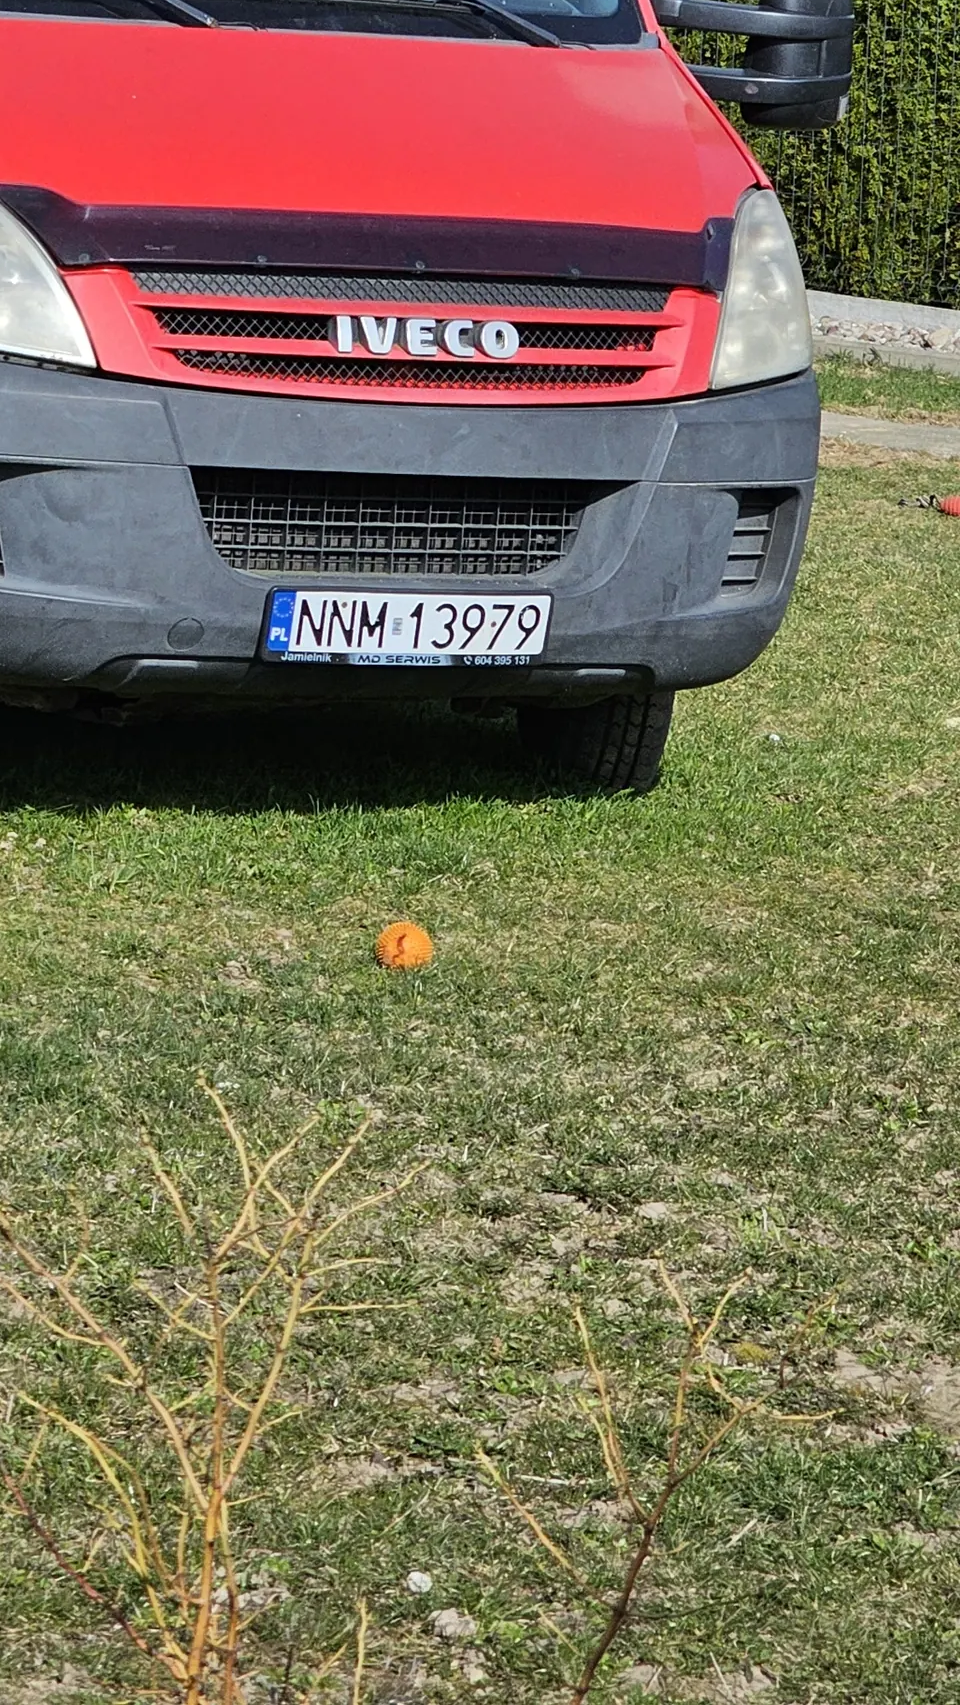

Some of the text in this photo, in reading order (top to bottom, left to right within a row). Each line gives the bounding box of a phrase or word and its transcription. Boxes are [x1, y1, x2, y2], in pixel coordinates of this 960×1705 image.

[335, 315, 520, 359] IVECO
[296, 599, 541, 650] NNM 13979
[270, 627, 288, 642] PL
[281, 651, 332, 663] Jamielnik
[357, 655, 441, 665] MD SERWIS
[474, 656, 493, 666] 604
